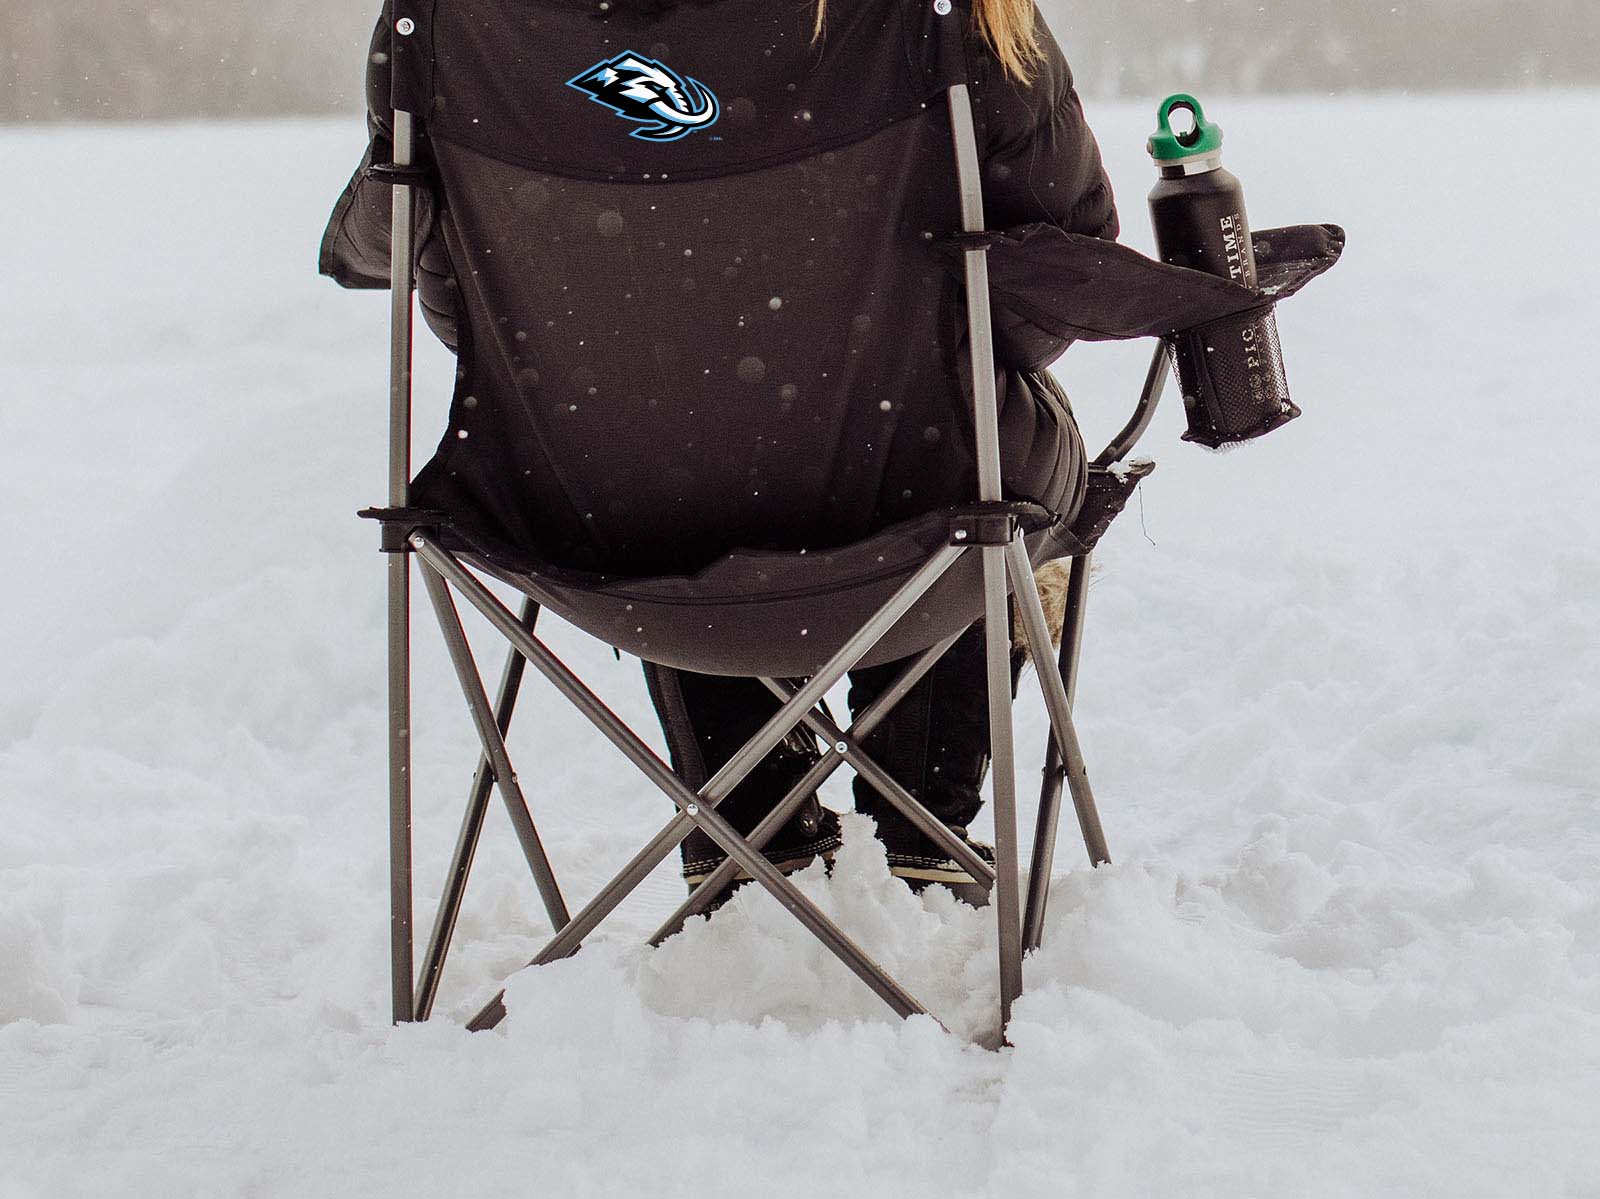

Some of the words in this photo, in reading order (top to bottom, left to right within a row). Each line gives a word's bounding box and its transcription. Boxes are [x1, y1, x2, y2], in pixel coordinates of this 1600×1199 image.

[1220, 215, 1242, 279] TIME
[1233, 212, 1251, 278] BRANDS
[1242, 328, 1260, 369] PIC
